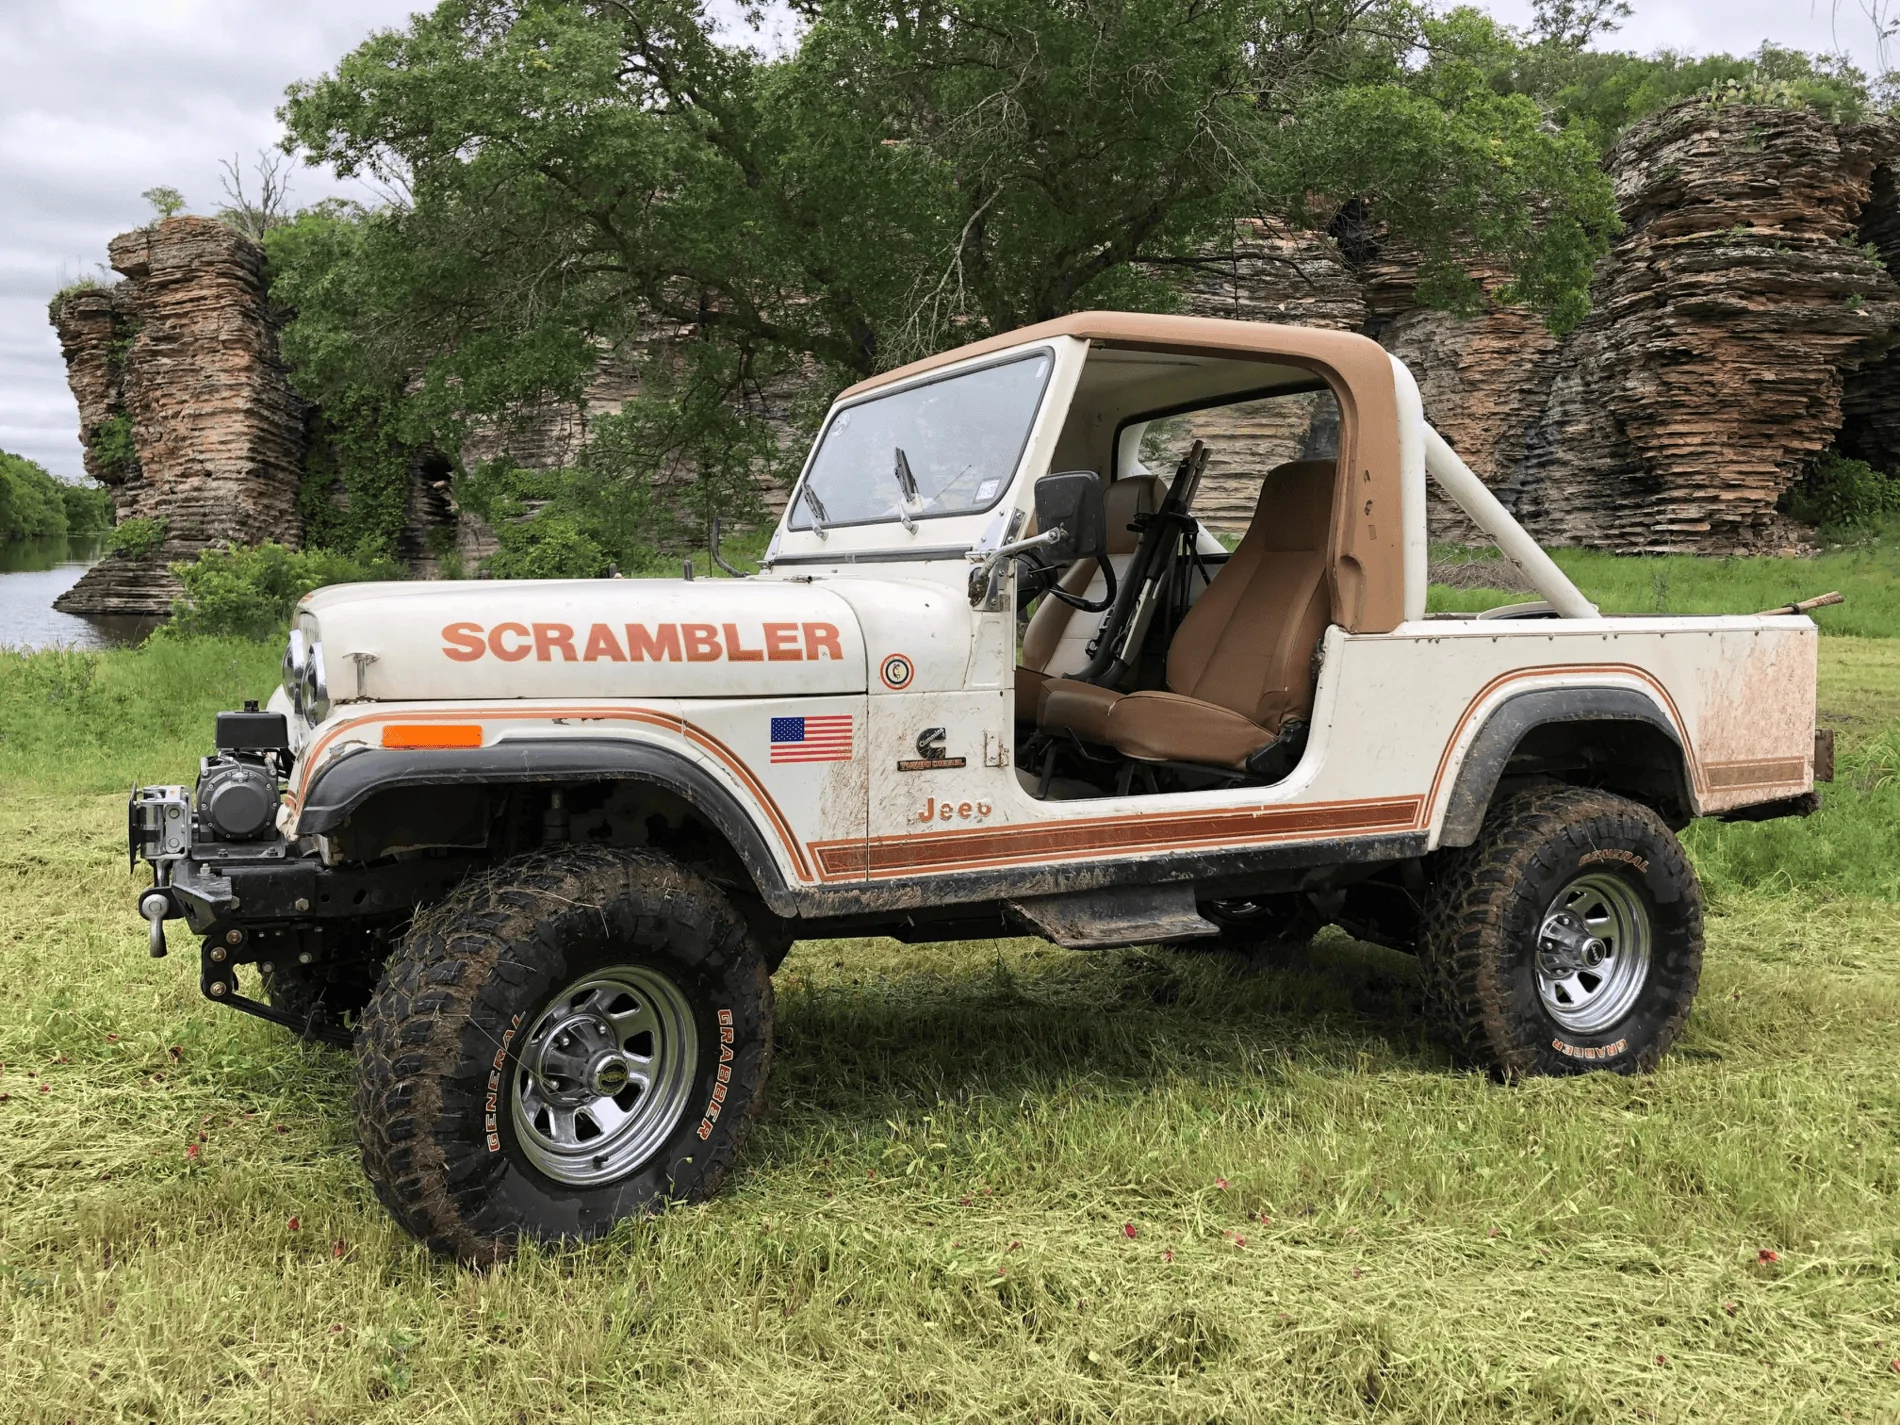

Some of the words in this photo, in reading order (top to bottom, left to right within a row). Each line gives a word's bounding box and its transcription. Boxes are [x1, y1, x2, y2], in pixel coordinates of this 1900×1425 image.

[441, 622, 843, 662] SCRAMBLER
[918, 797, 992, 822] Jeep
[1579, 849, 1649, 873] GENERAL
[1552, 1038, 1628, 1058] GRABBER
[485, 1010, 526, 1152] GENERAL
[697, 1009, 734, 1140] GRABBER
